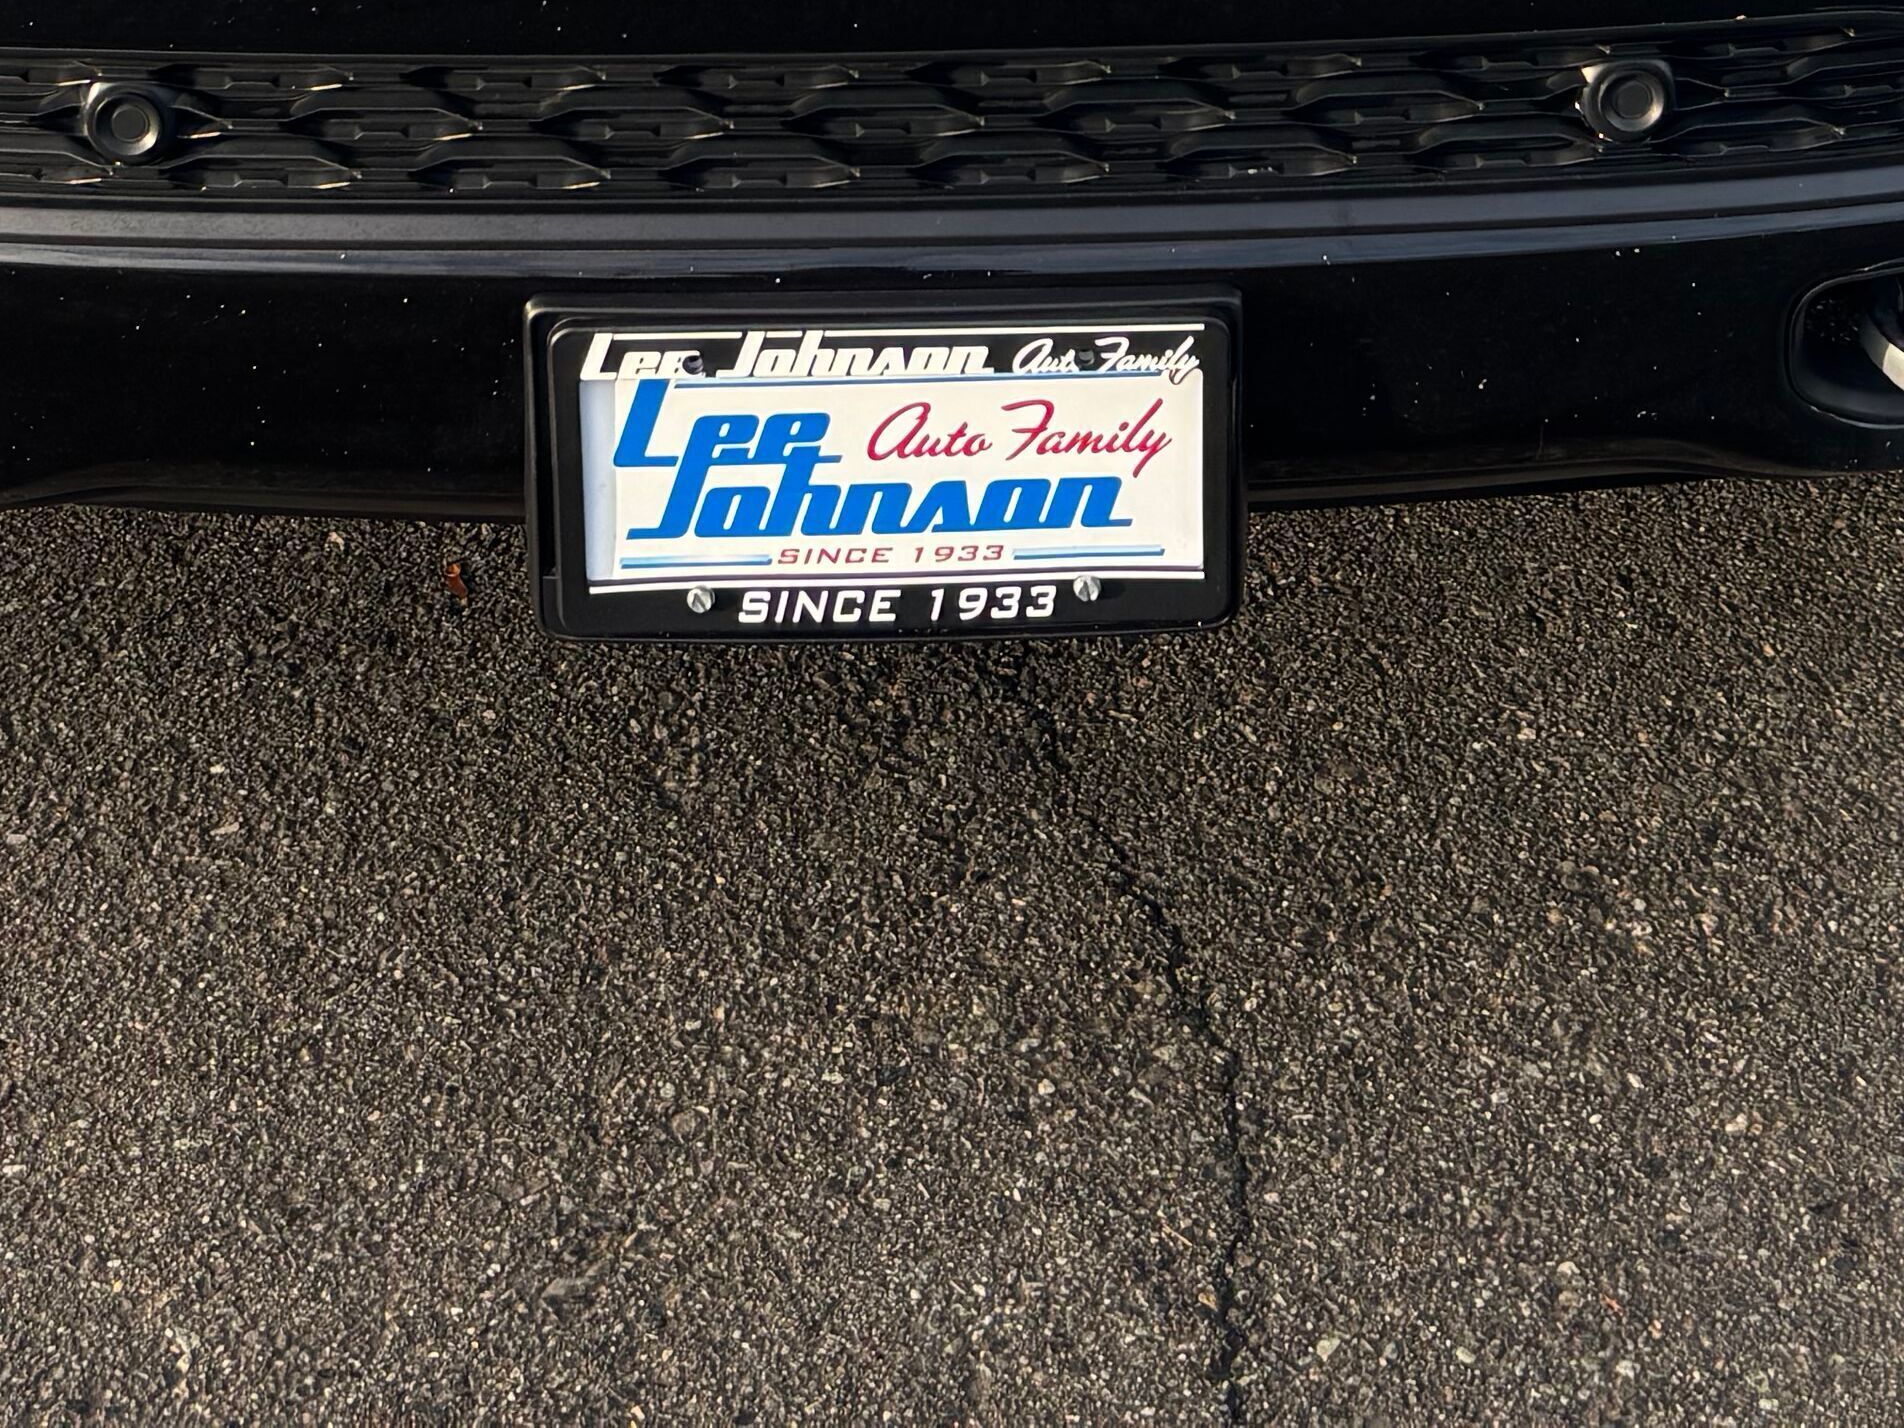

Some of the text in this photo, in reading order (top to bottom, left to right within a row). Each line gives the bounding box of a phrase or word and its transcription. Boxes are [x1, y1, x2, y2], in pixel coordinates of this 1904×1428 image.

[580, 333, 706, 380] Lee
[716, 330, 994, 378] Johnson
[1095, 336, 1199, 385] Family
[613, 379, 1173, 478] Lee Auto Family
[626, 450, 1133, 540] Johnson
[777, 544, 1005, 565] SINCE 1933
[738, 584, 1057, 624] SINCE 1933
